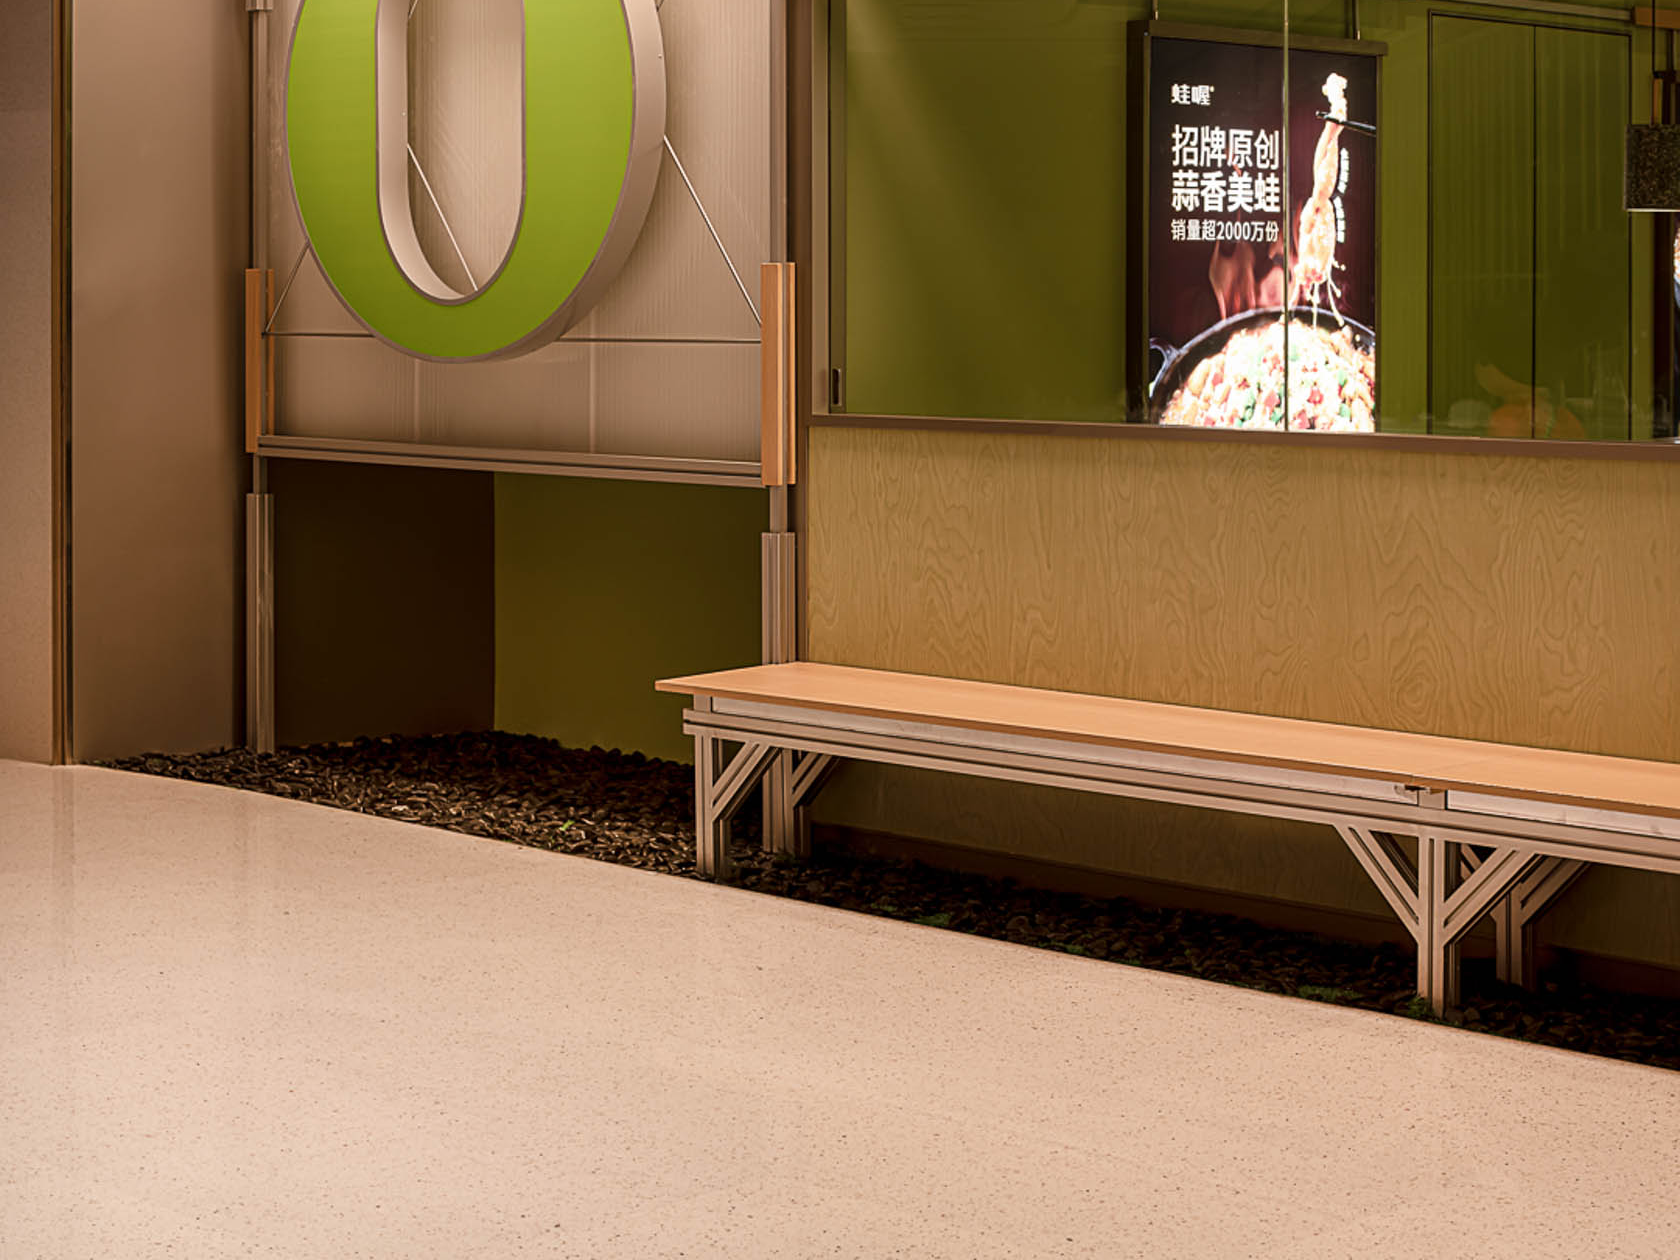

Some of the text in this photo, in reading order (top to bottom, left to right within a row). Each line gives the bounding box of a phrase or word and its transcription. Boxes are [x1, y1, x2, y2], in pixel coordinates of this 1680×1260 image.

[1171, 124, 1280, 169] 招牌原创
[1171, 170, 1281, 214] 蒜香美蛙
[1170, 218, 1280, 243] 销量超2000万份
